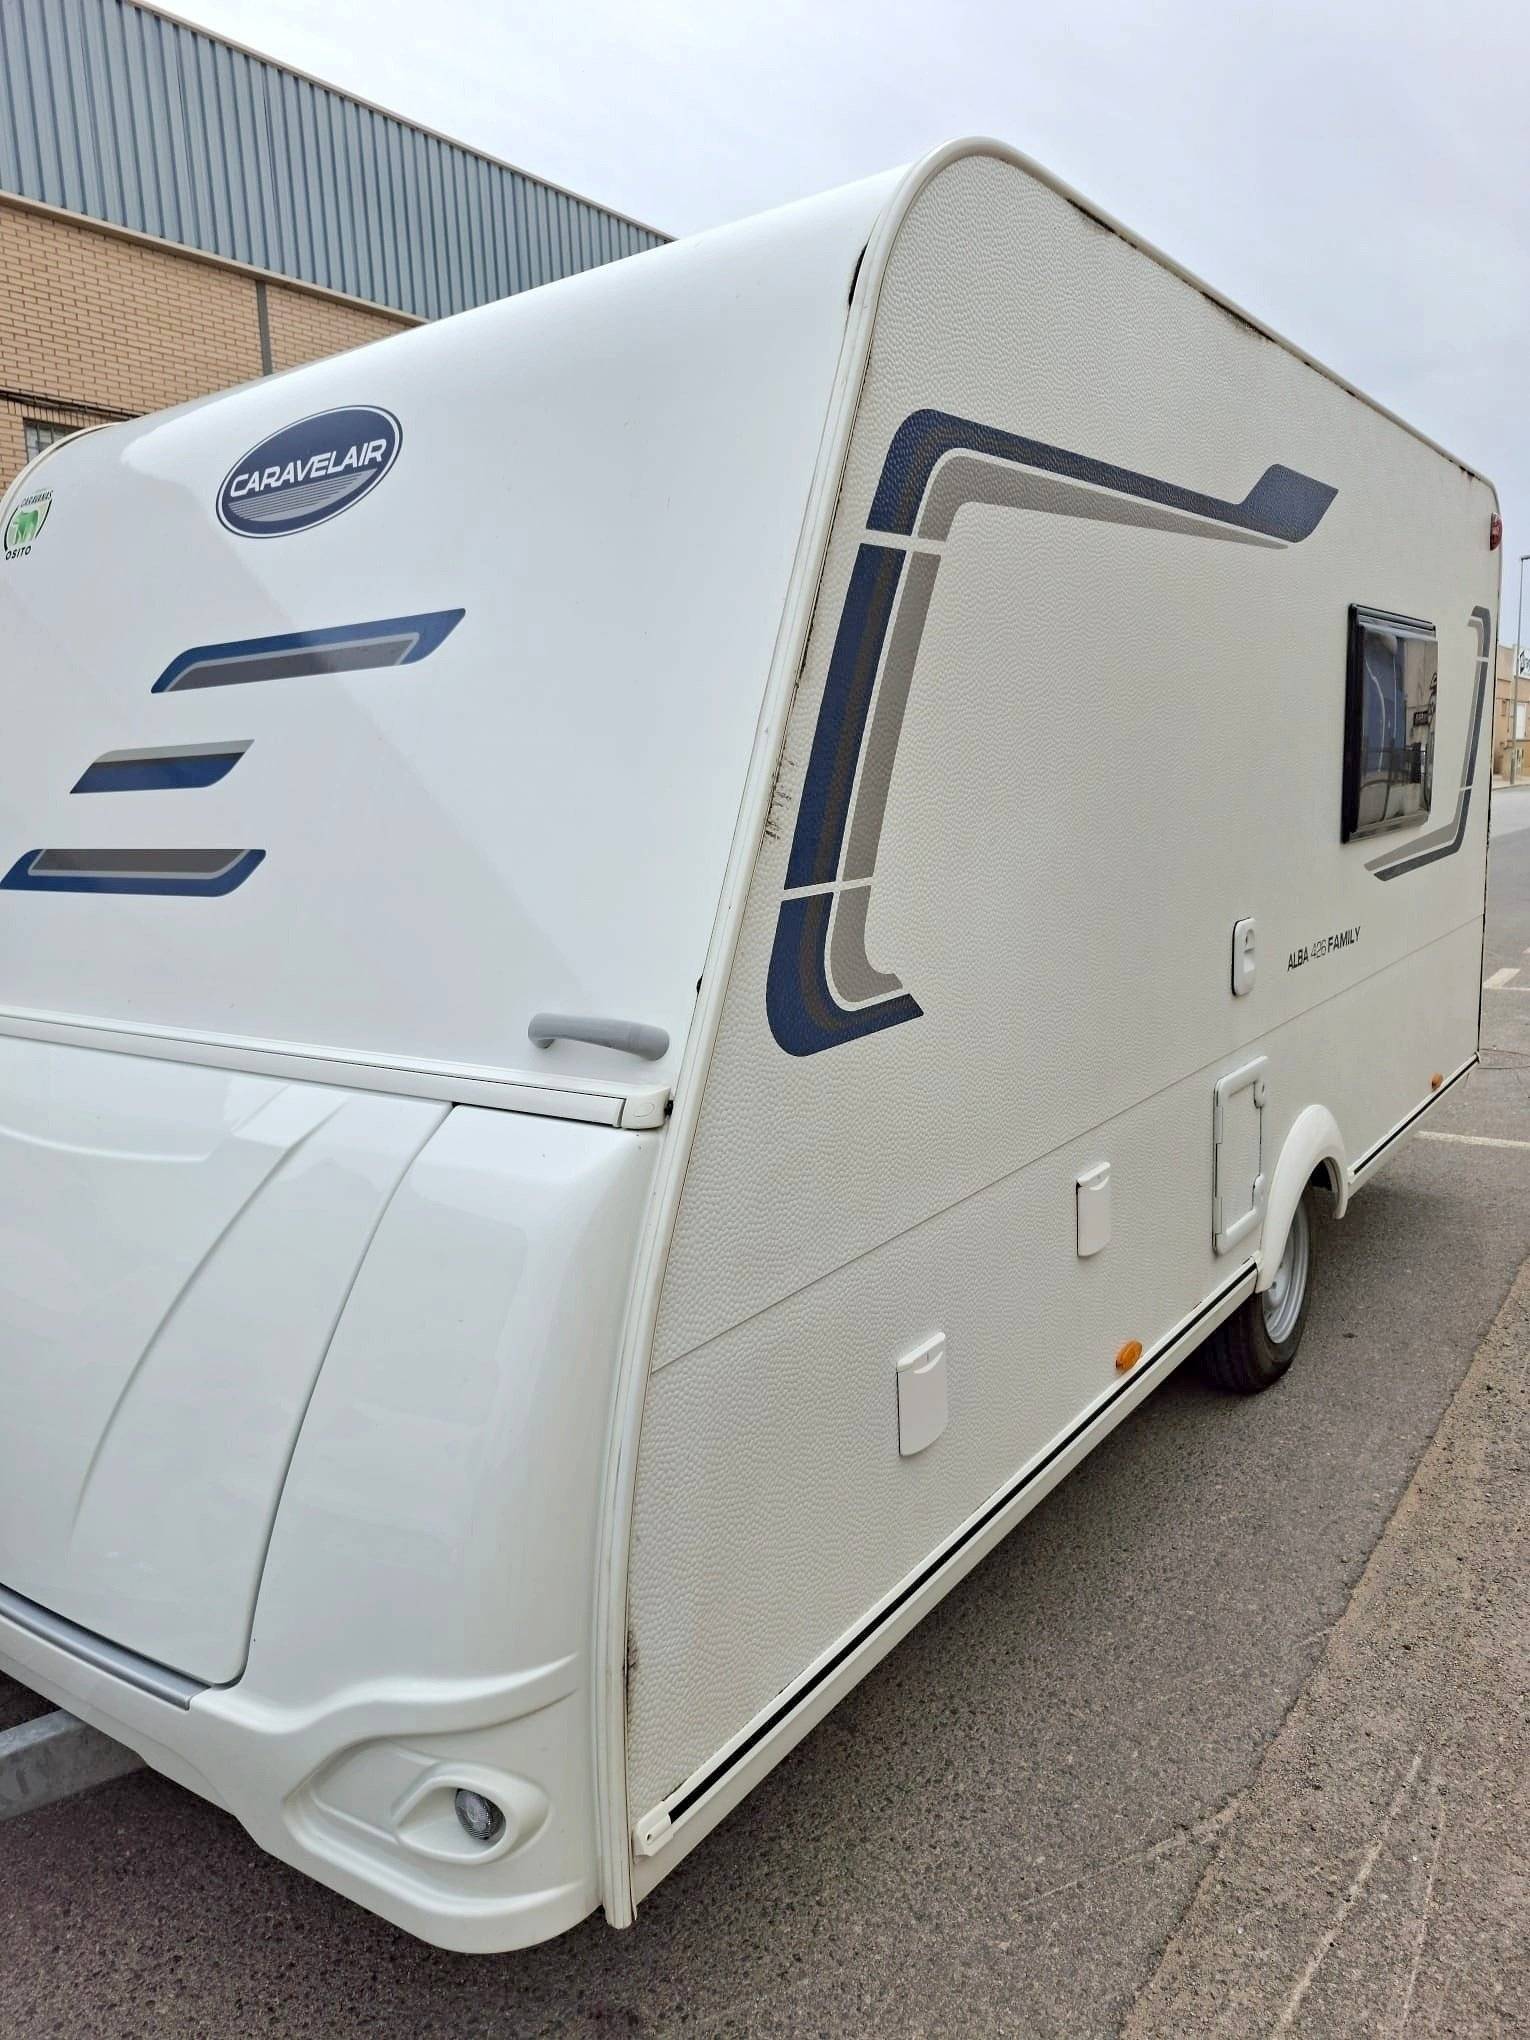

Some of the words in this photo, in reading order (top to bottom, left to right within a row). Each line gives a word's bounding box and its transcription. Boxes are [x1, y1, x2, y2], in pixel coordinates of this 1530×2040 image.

[230, 439, 387, 498] CARAVELAIR
[5, 545, 32, 560] OSITO
[1287, 946, 1309, 972] ALBA
[1327, 926, 1361, 953] FAMILY
